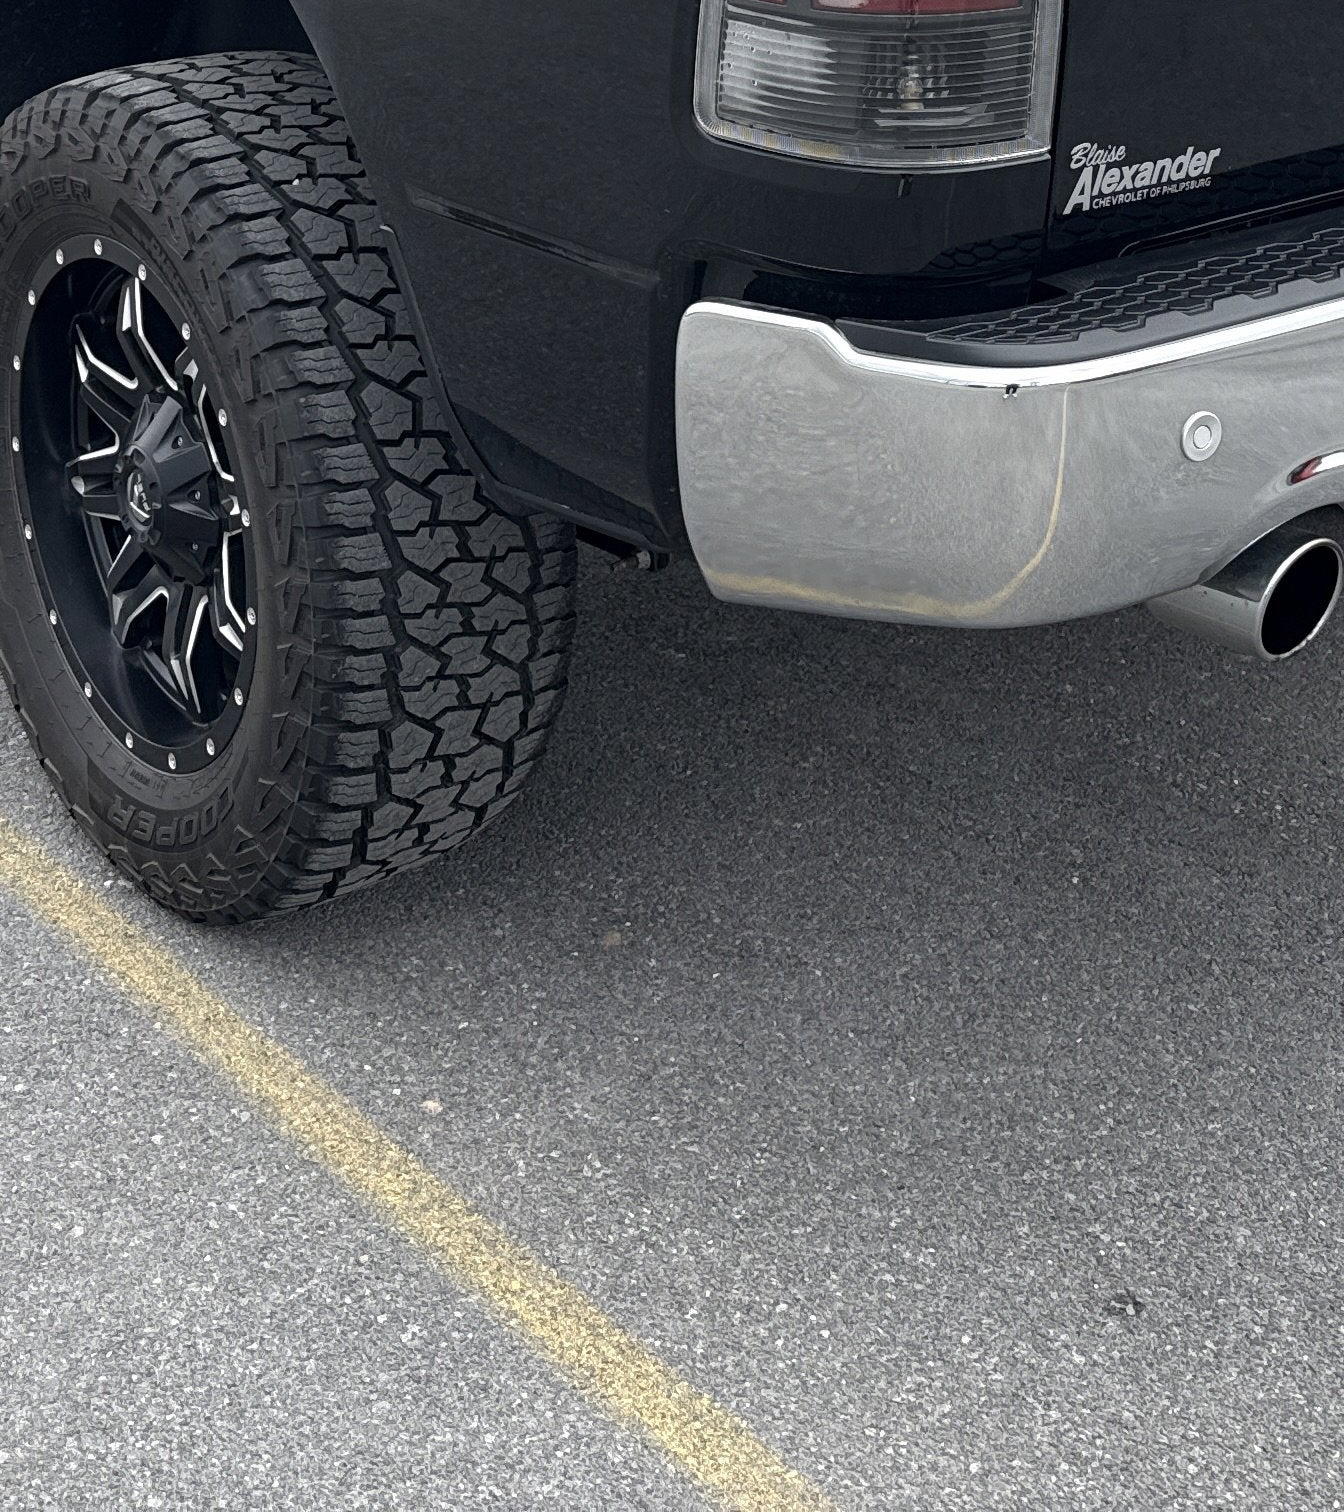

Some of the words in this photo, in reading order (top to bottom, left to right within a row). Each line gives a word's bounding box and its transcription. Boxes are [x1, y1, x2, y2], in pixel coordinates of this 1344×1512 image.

[1070, 143, 1126, 170] Blaise
[1063, 146, 1221, 215] Alexander
[1092, 188, 1150, 209] CHEVROLET
[1150, 186, 1162, 199] OF
[1162, 177, 1212, 196] PHILIPSBURG
[107, 784, 234, 846] COOPER
